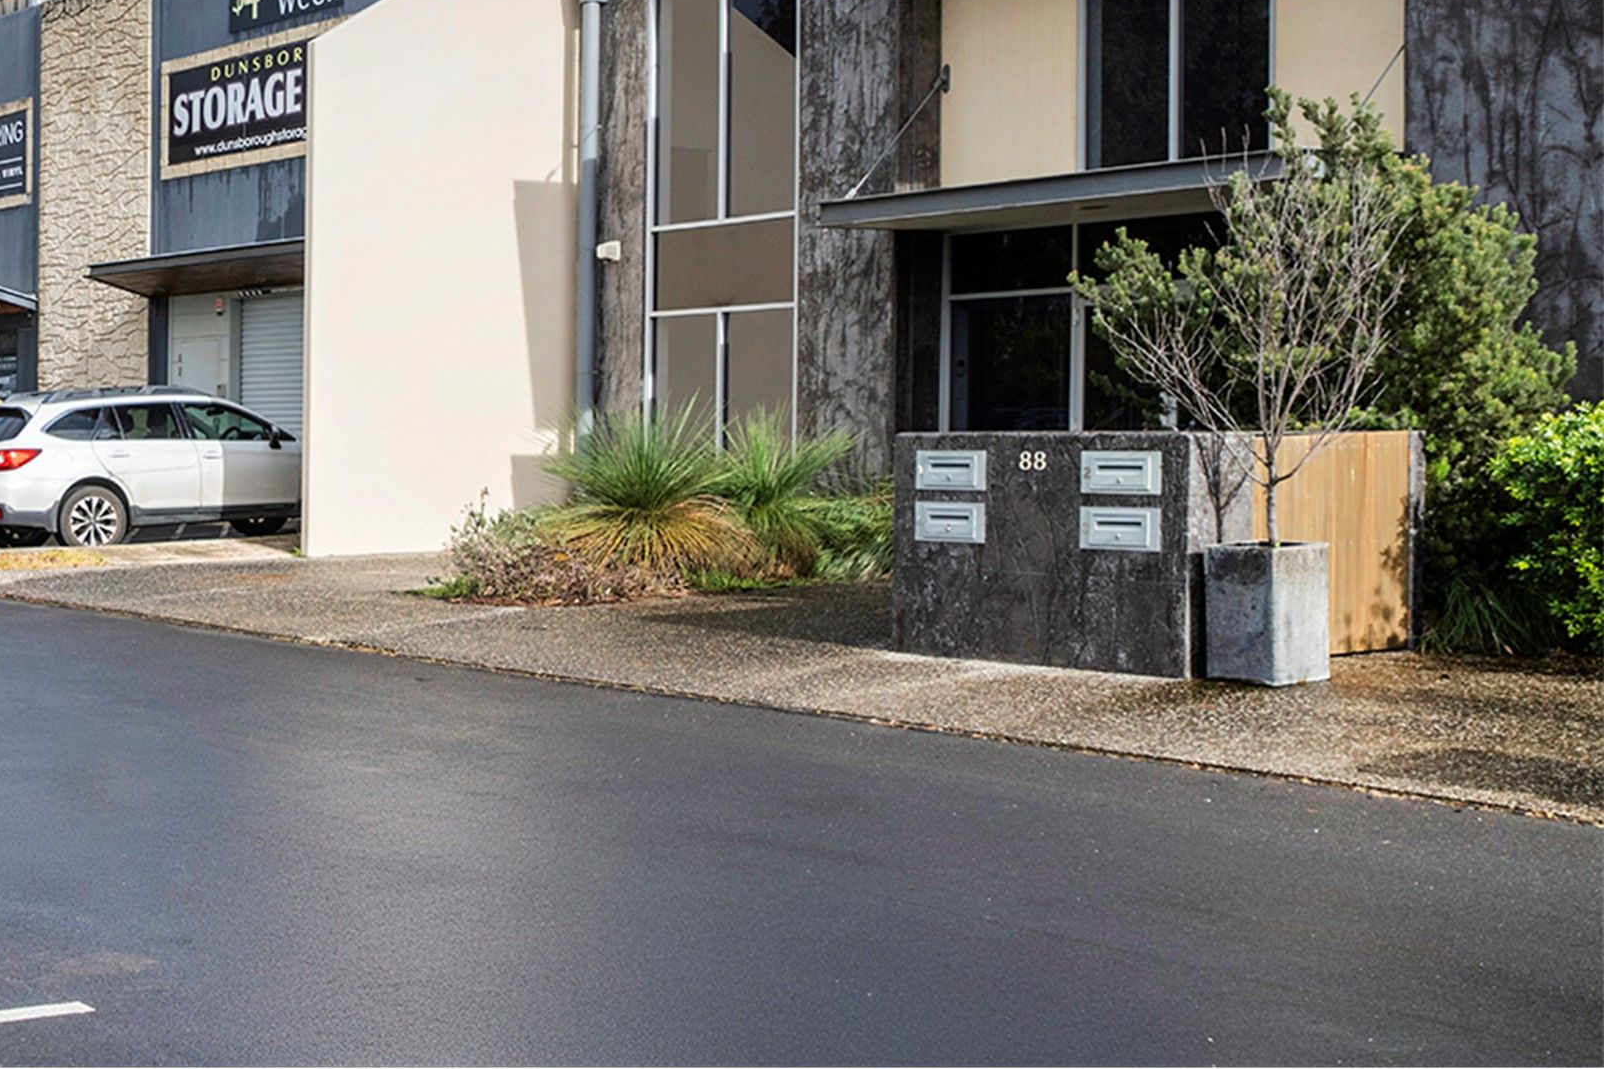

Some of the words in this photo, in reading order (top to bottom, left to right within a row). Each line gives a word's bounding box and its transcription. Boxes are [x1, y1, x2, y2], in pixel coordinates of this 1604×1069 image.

[173, 68, 303, 137] STORAGE
[1018, 450, 1047, 471] 88
[1082, 466, 1092, 480] 2
